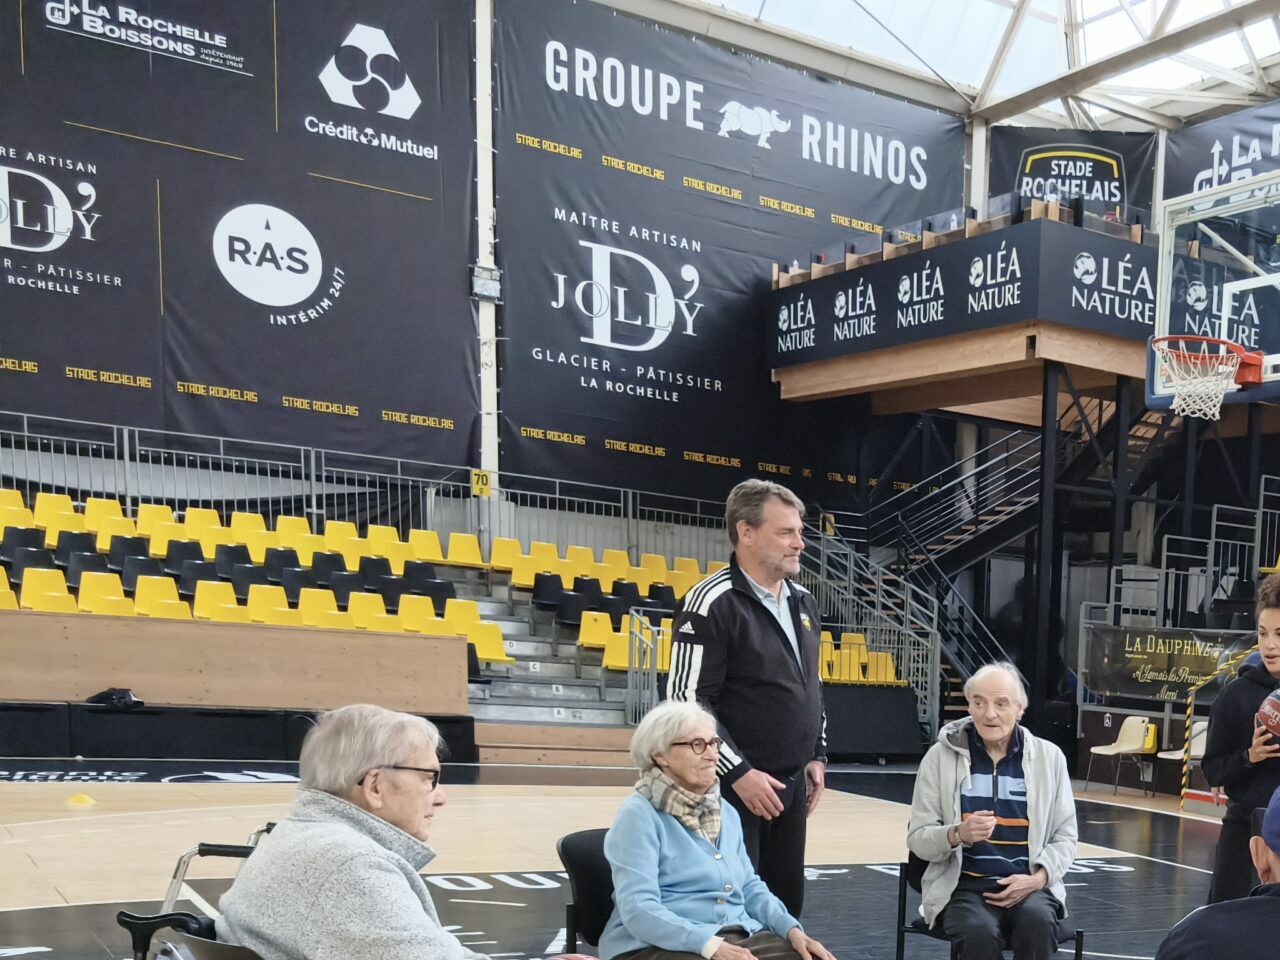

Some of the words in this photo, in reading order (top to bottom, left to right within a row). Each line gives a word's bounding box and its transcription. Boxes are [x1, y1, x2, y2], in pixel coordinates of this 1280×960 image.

[82, 14, 196, 57] BOISSONS
[118, 5, 228, 48] ROCHELLE
[545, 40, 705, 131] GROUPE
[802, 114, 928, 191] RHINOS
[305, 116, 359, 143] Crédit
[380, 132, 439, 161] Mutuel
[516, 133, 540, 149] STADE
[542, 140, 583, 159] ROCHELAIS
[1232, 134, 1263, 167] LA
[26, 152, 97, 175] ARTISAN
[602, 155, 625, 170] STADE
[626, 161, 665, 181] ROCHELAIS
[1051, 160, 1094, 177] STADE
[683, 177, 705, 190] STADE
[706, 182, 742, 200] ROCHELAIS
[1020, 177, 1122, 202] ROCHELAIS
[759, 195, 780, 210] STADE
[780, 200, 815, 219] ROCHELAIS
[554, 207, 620, 236] MAÎTRE
[630, 225, 702, 254] ARTISAN
[831, 213, 851, 228] STADE
[851, 218, 884, 235] ROCHELAIS
[37, 263, 123, 287] PÂTISSIER
[985, 239, 1022, 287] LÉA
[1101, 242, 1156, 302] LÉA
[7, 275, 80, 295] ROCHELLE
[913, 260, 944, 303] LÉA
[269, 297, 333, 326] INTÉRIM
[329, 266, 345, 299] 24/7
[848, 277, 876, 316] LÉA
[967, 281, 1022, 315] NATURE
[1071, 285, 1156, 328] NATURE
[790, 293, 816, 330] LÉA
[896, 299, 945, 329] NATURE
[777, 327, 816, 354] NATURE
[833, 313, 877, 343] NATURE
[66, 367, 98, 382] STADE
[100, 371, 152, 389] ROCHELAIS
[532, 347, 611, 373] GLACIER
[637, 365, 723, 393] PÂTISSIER
[177, 382, 207, 396] STADE
[209, 386, 258, 403] ROCHELAIS
[580, 376, 598, 390] LA
[605, 380, 680, 403] ROCHELLE
[282, 396, 311, 410] STADE
[313, 400, 359, 417] ROCHELAIS
[382, 410, 408, 424] STADE
[410, 414, 454, 430] ROCHELAIS
[520, 427, 545, 440] STADE
[546, 431, 586, 446] ROCHELAIS
[604, 439, 627, 452] STADE
[628, 443, 666, 457] ROCHELAIS
[683, 451, 705, 463] STADE
[706, 454, 741, 468] ROCHELAIS
[474, 473, 489, 487] 70
[1125, 633, 1142, 651] LA
[1156, 683, 1179, 700] Merci
